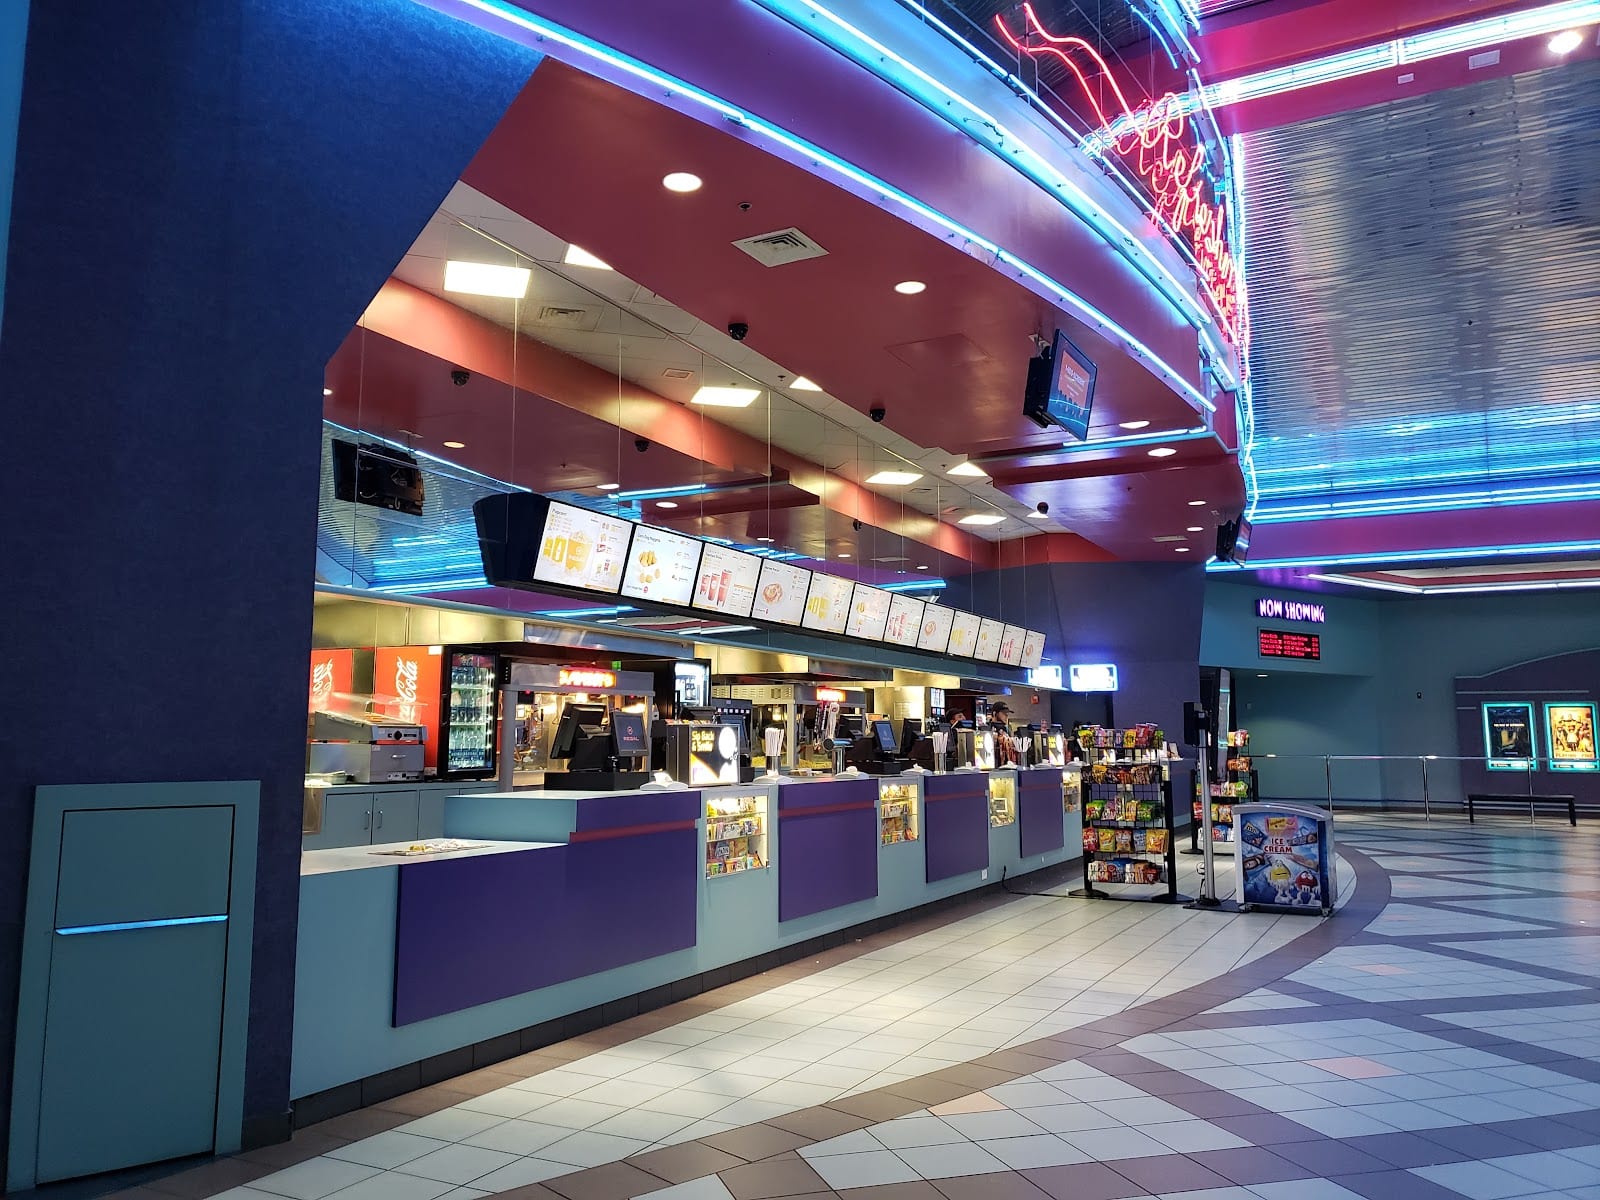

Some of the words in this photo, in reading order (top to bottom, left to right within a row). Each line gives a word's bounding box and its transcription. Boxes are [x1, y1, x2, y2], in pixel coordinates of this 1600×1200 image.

[1259, 599, 1283, 617] NOW
[1285, 602, 1325, 623] SHOWING
[1263, 845, 1293, 853] CREAM
